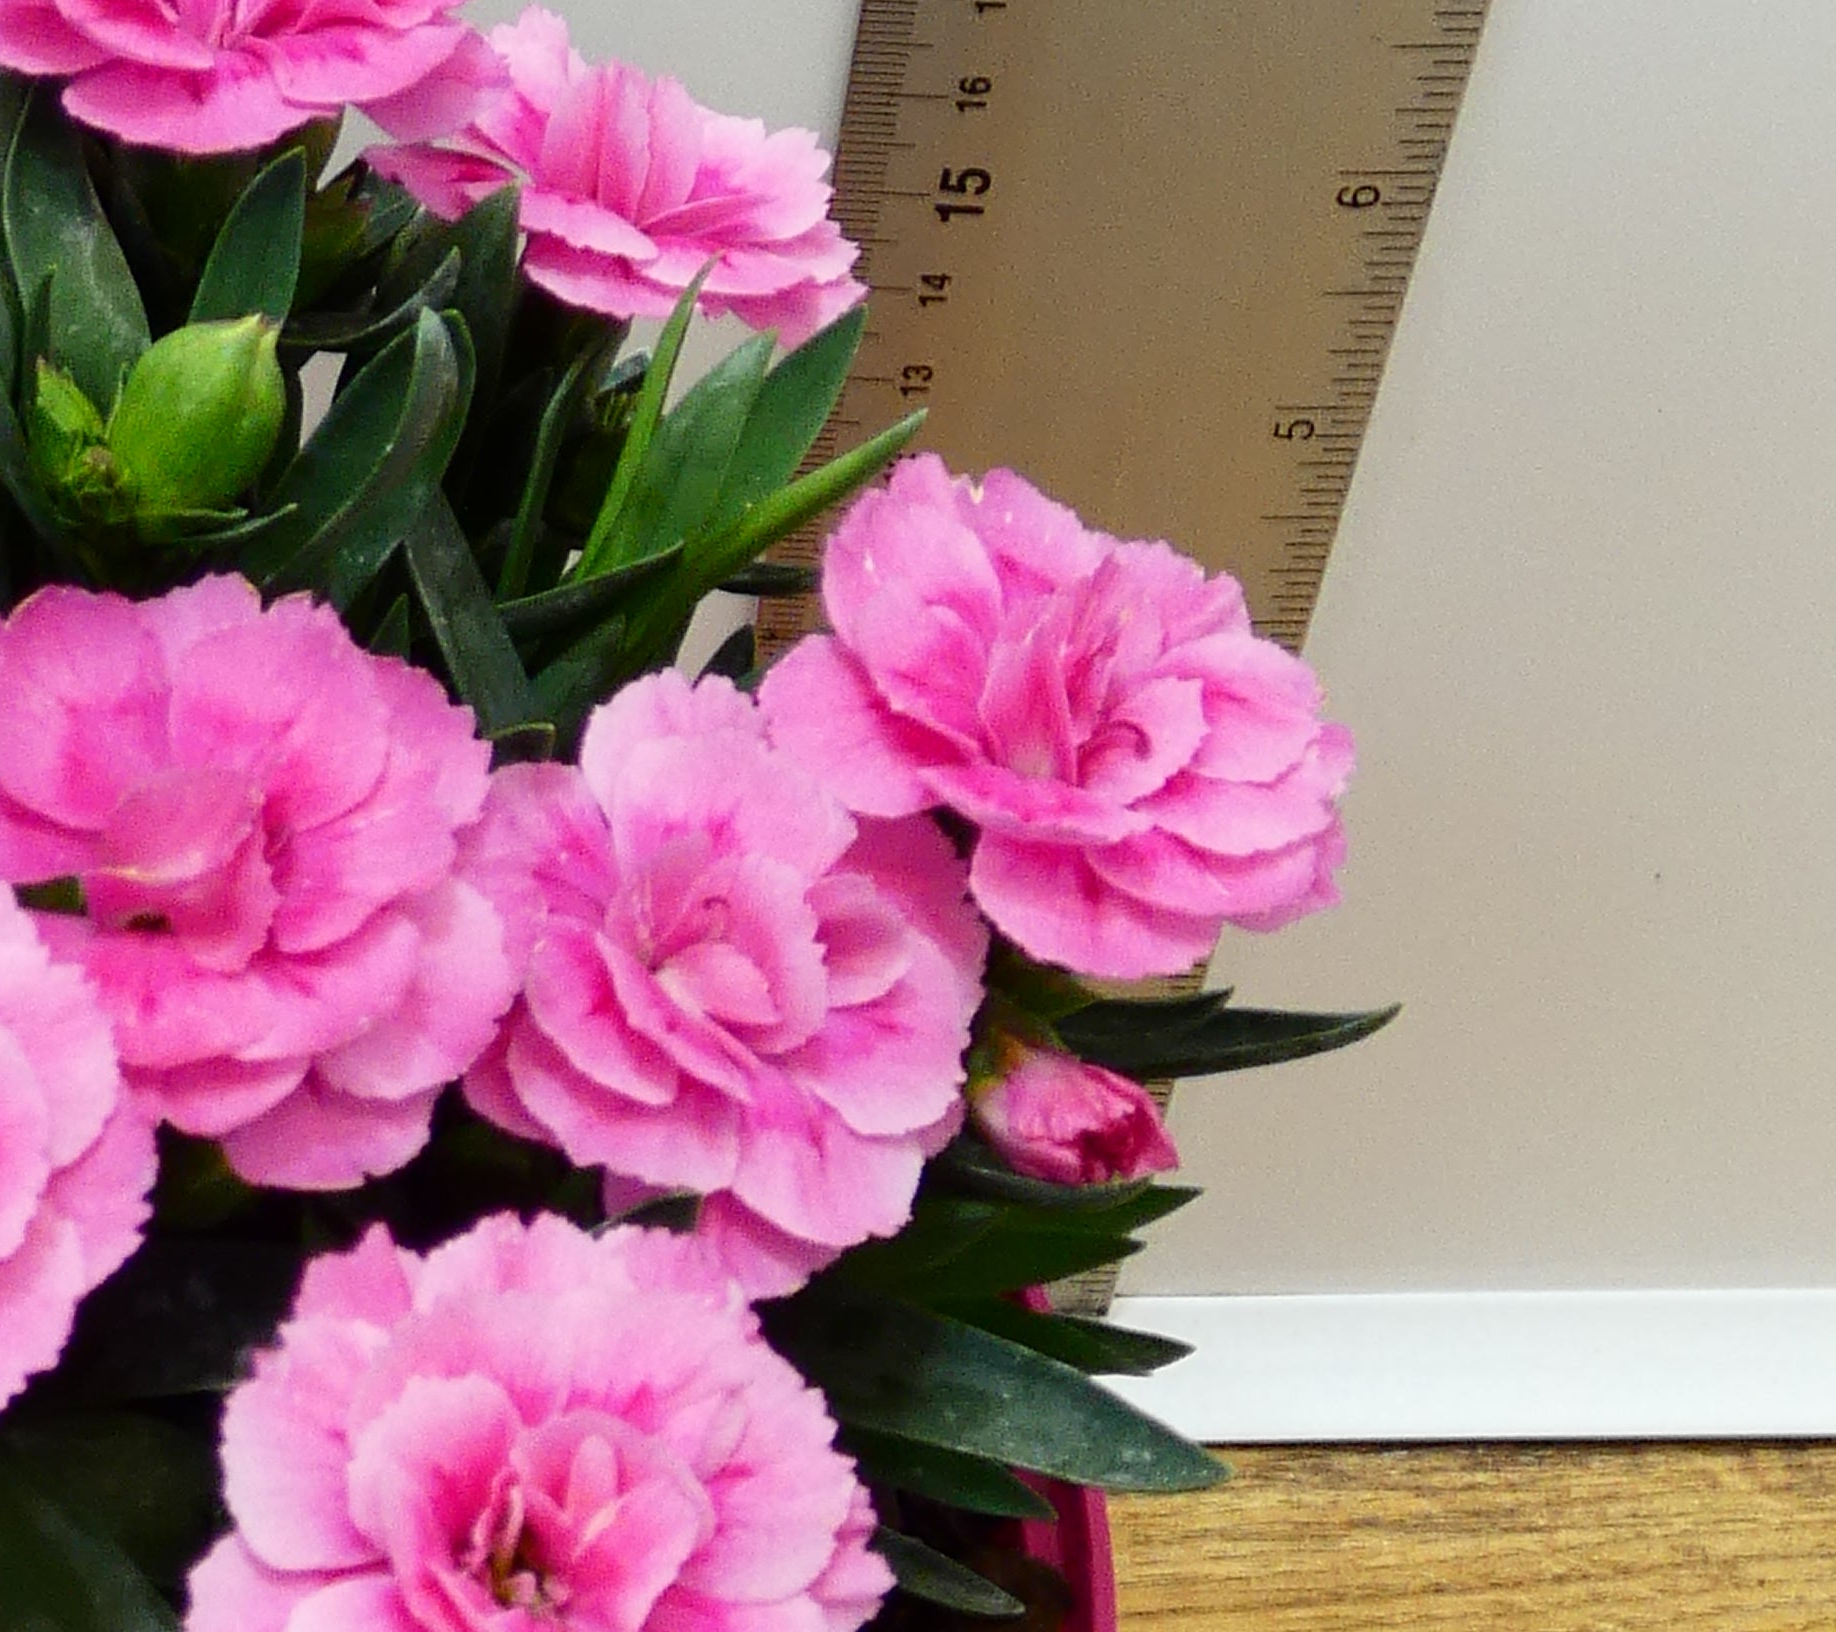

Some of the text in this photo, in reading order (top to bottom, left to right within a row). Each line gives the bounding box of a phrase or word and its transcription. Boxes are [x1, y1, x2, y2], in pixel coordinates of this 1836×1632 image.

[955, 76, 992, 114] 16
[933, 167, 992, 223] 15
[1335, 185, 1381, 210] 6
[917, 273, 952, 308] 14
[899, 364, 934, 398] 13
[1272, 419, 1316, 441] 5
